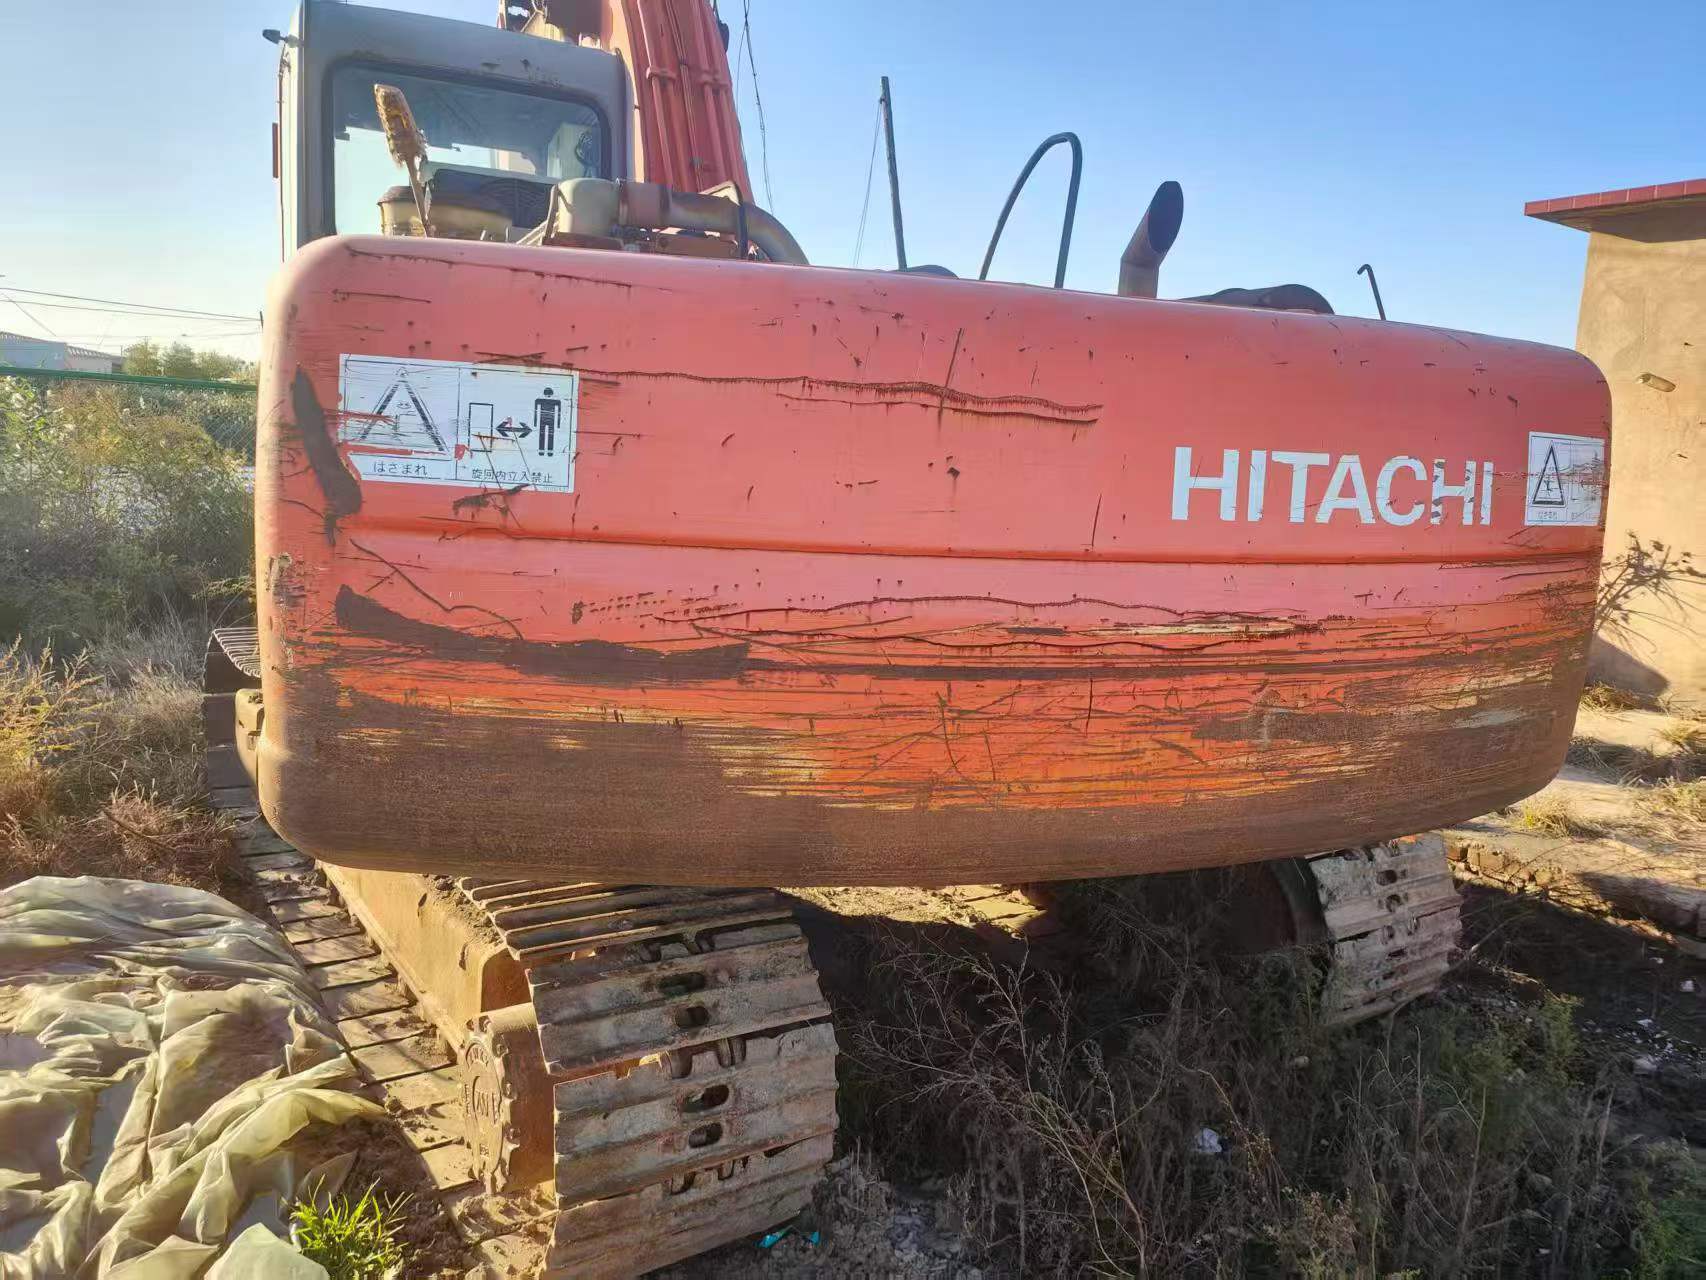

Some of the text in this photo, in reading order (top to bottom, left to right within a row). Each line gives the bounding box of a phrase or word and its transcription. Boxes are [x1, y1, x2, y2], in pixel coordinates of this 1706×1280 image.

[373, 461, 428, 476] はさまれ
[1171, 446, 1495, 526] HITACHI
